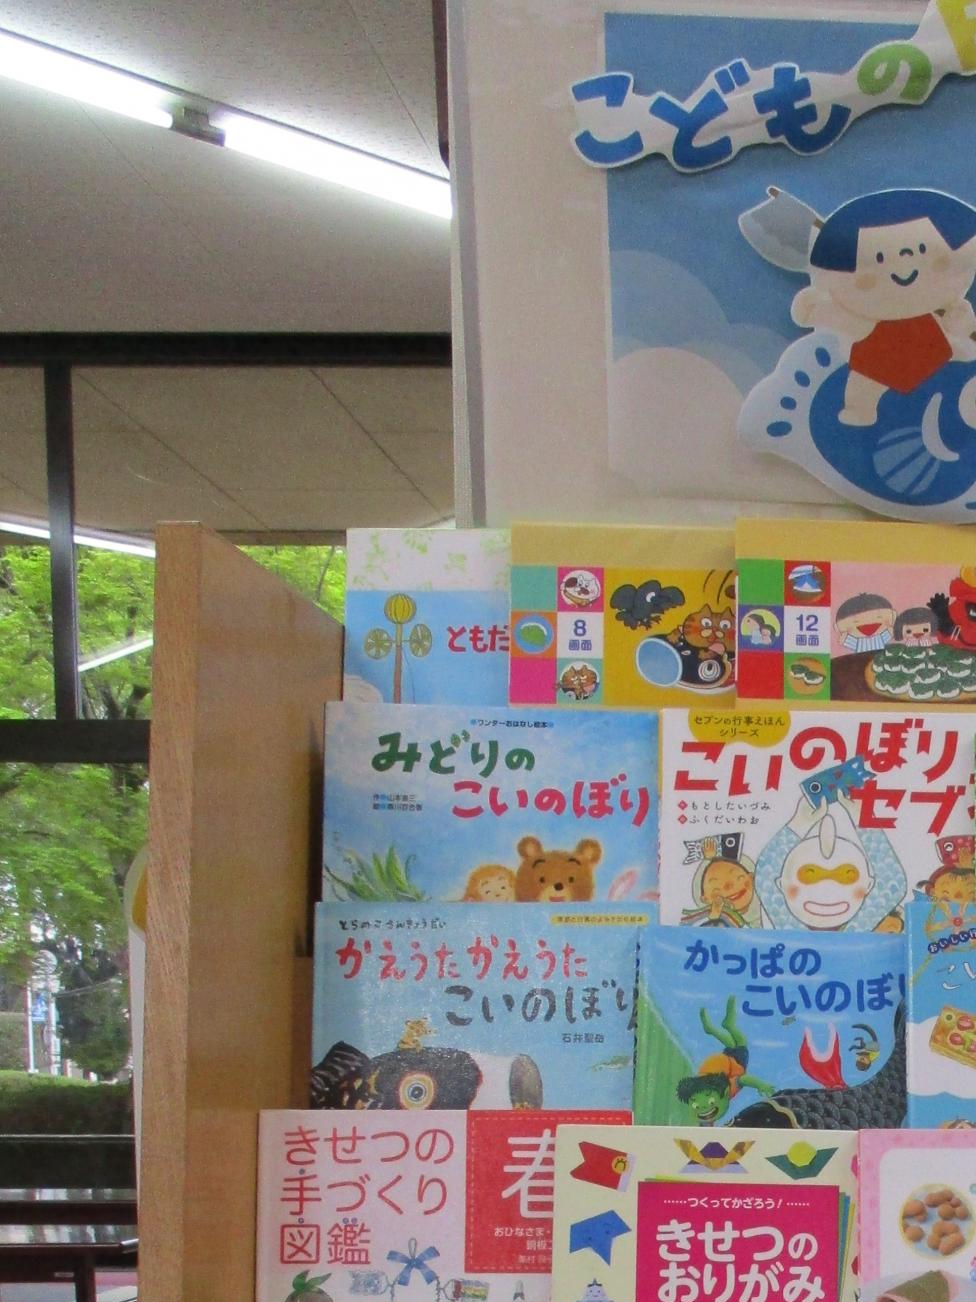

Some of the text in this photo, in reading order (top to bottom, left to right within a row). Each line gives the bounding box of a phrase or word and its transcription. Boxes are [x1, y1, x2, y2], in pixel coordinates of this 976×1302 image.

[573, 619, 588, 636] 8
[796, 614, 819, 632] 12
[694, 715, 785, 727] セブンの行事えほん
[719, 729, 760, 738] シリーズ
[372, 730, 535, 778] みどりの
[674, 719, 959, 797] こいのぼり
[452, 773, 650, 827] こいのぼり
[690, 801, 771, 811] もとしたいづみ
[849, 773, 976, 837] セブ
[689, 815, 761, 825] ふくだいわお
[683, 939, 822, 978] かっぱの
[284, 1126, 455, 1165] きせつの
[280, 1174, 448, 1216] 手づくり
[687, 1197, 783, 1210] つくってかざろう!
[280, 1223, 371, 1265] 図鑑
[656, 1219, 818, 1262] きせつの
